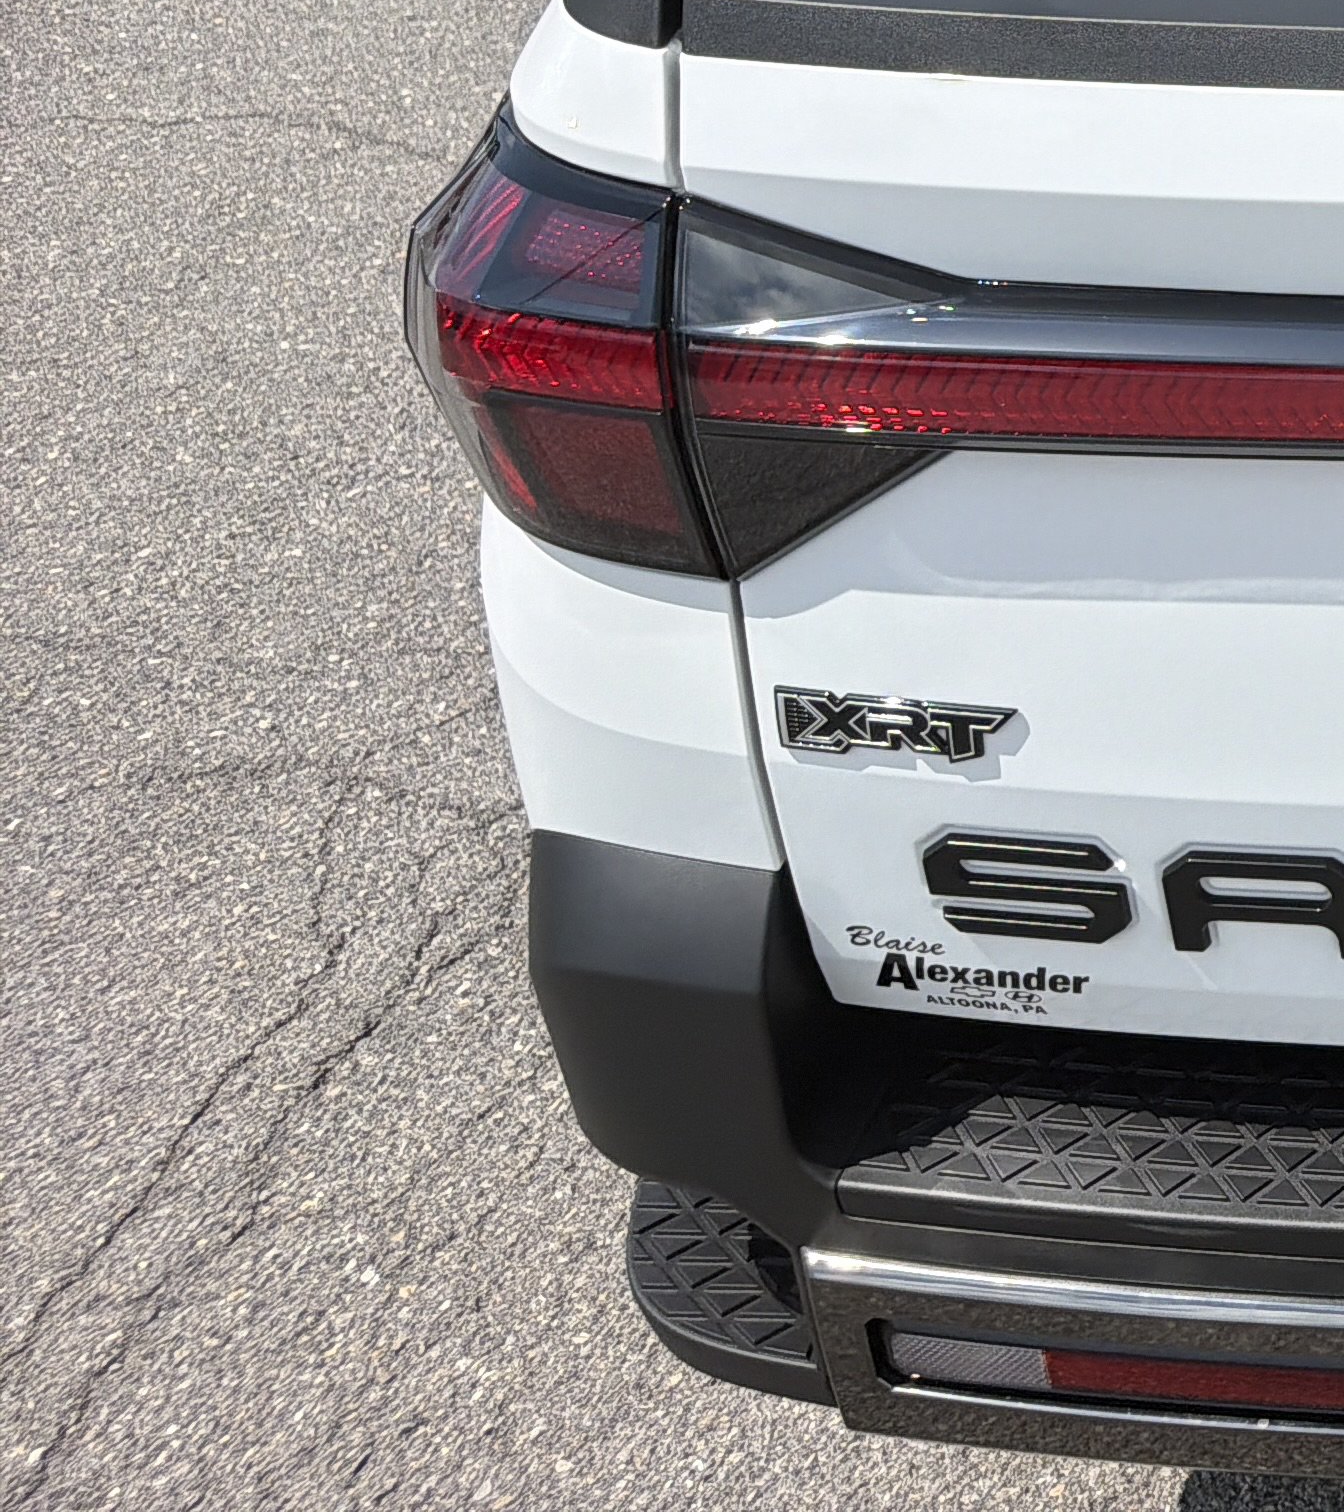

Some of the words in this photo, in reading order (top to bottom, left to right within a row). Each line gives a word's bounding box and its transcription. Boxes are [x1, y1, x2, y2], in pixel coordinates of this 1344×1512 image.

[774, 685, 1018, 764] XRT
[845, 924, 947, 957] Blaise
[876, 952, 1090, 995] Alexander
[926, 993, 1018, 1016] ALTOONA,
[1021, 1002, 1049, 1016] PA
